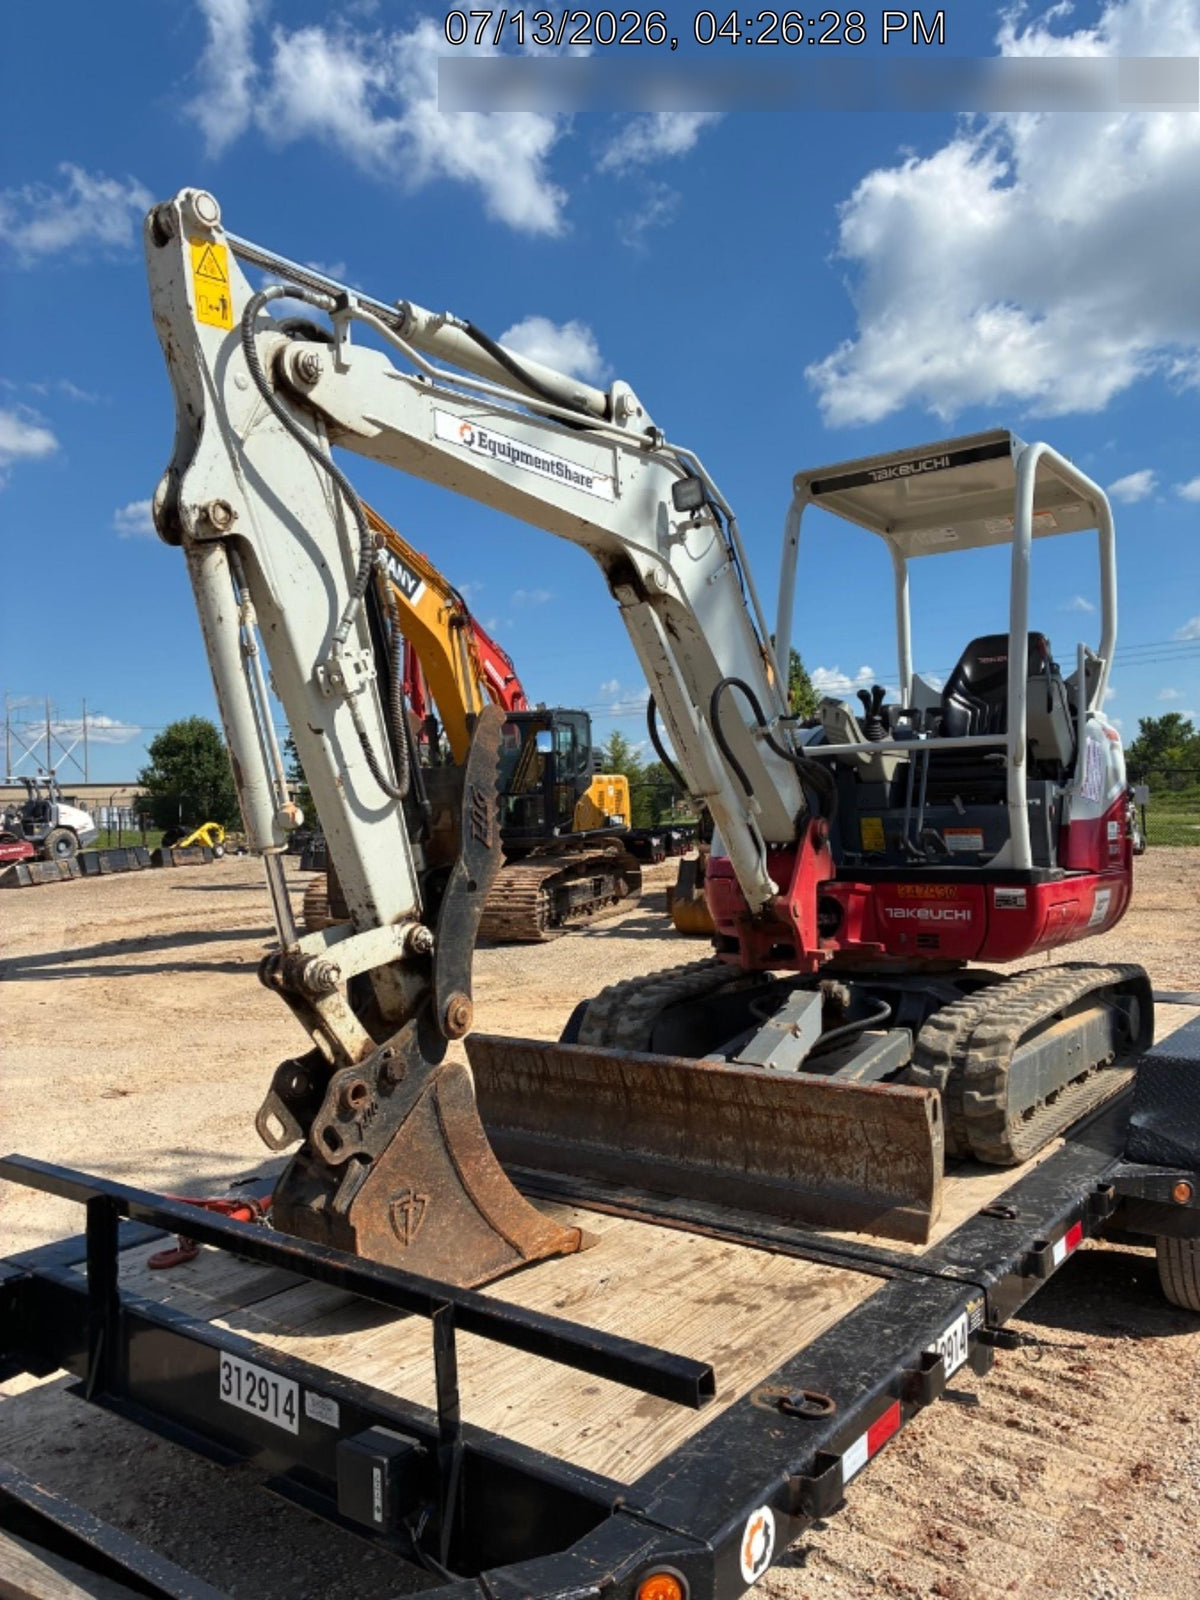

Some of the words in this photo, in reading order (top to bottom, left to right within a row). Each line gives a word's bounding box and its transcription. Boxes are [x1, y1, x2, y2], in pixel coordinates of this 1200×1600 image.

[478, 431, 593, 489] EquipmentShare
[868, 456, 950, 481] TAKEUCHI
[885, 907, 972, 921] TAKEUCHI
[221, 1361, 296, 1426] 312914
